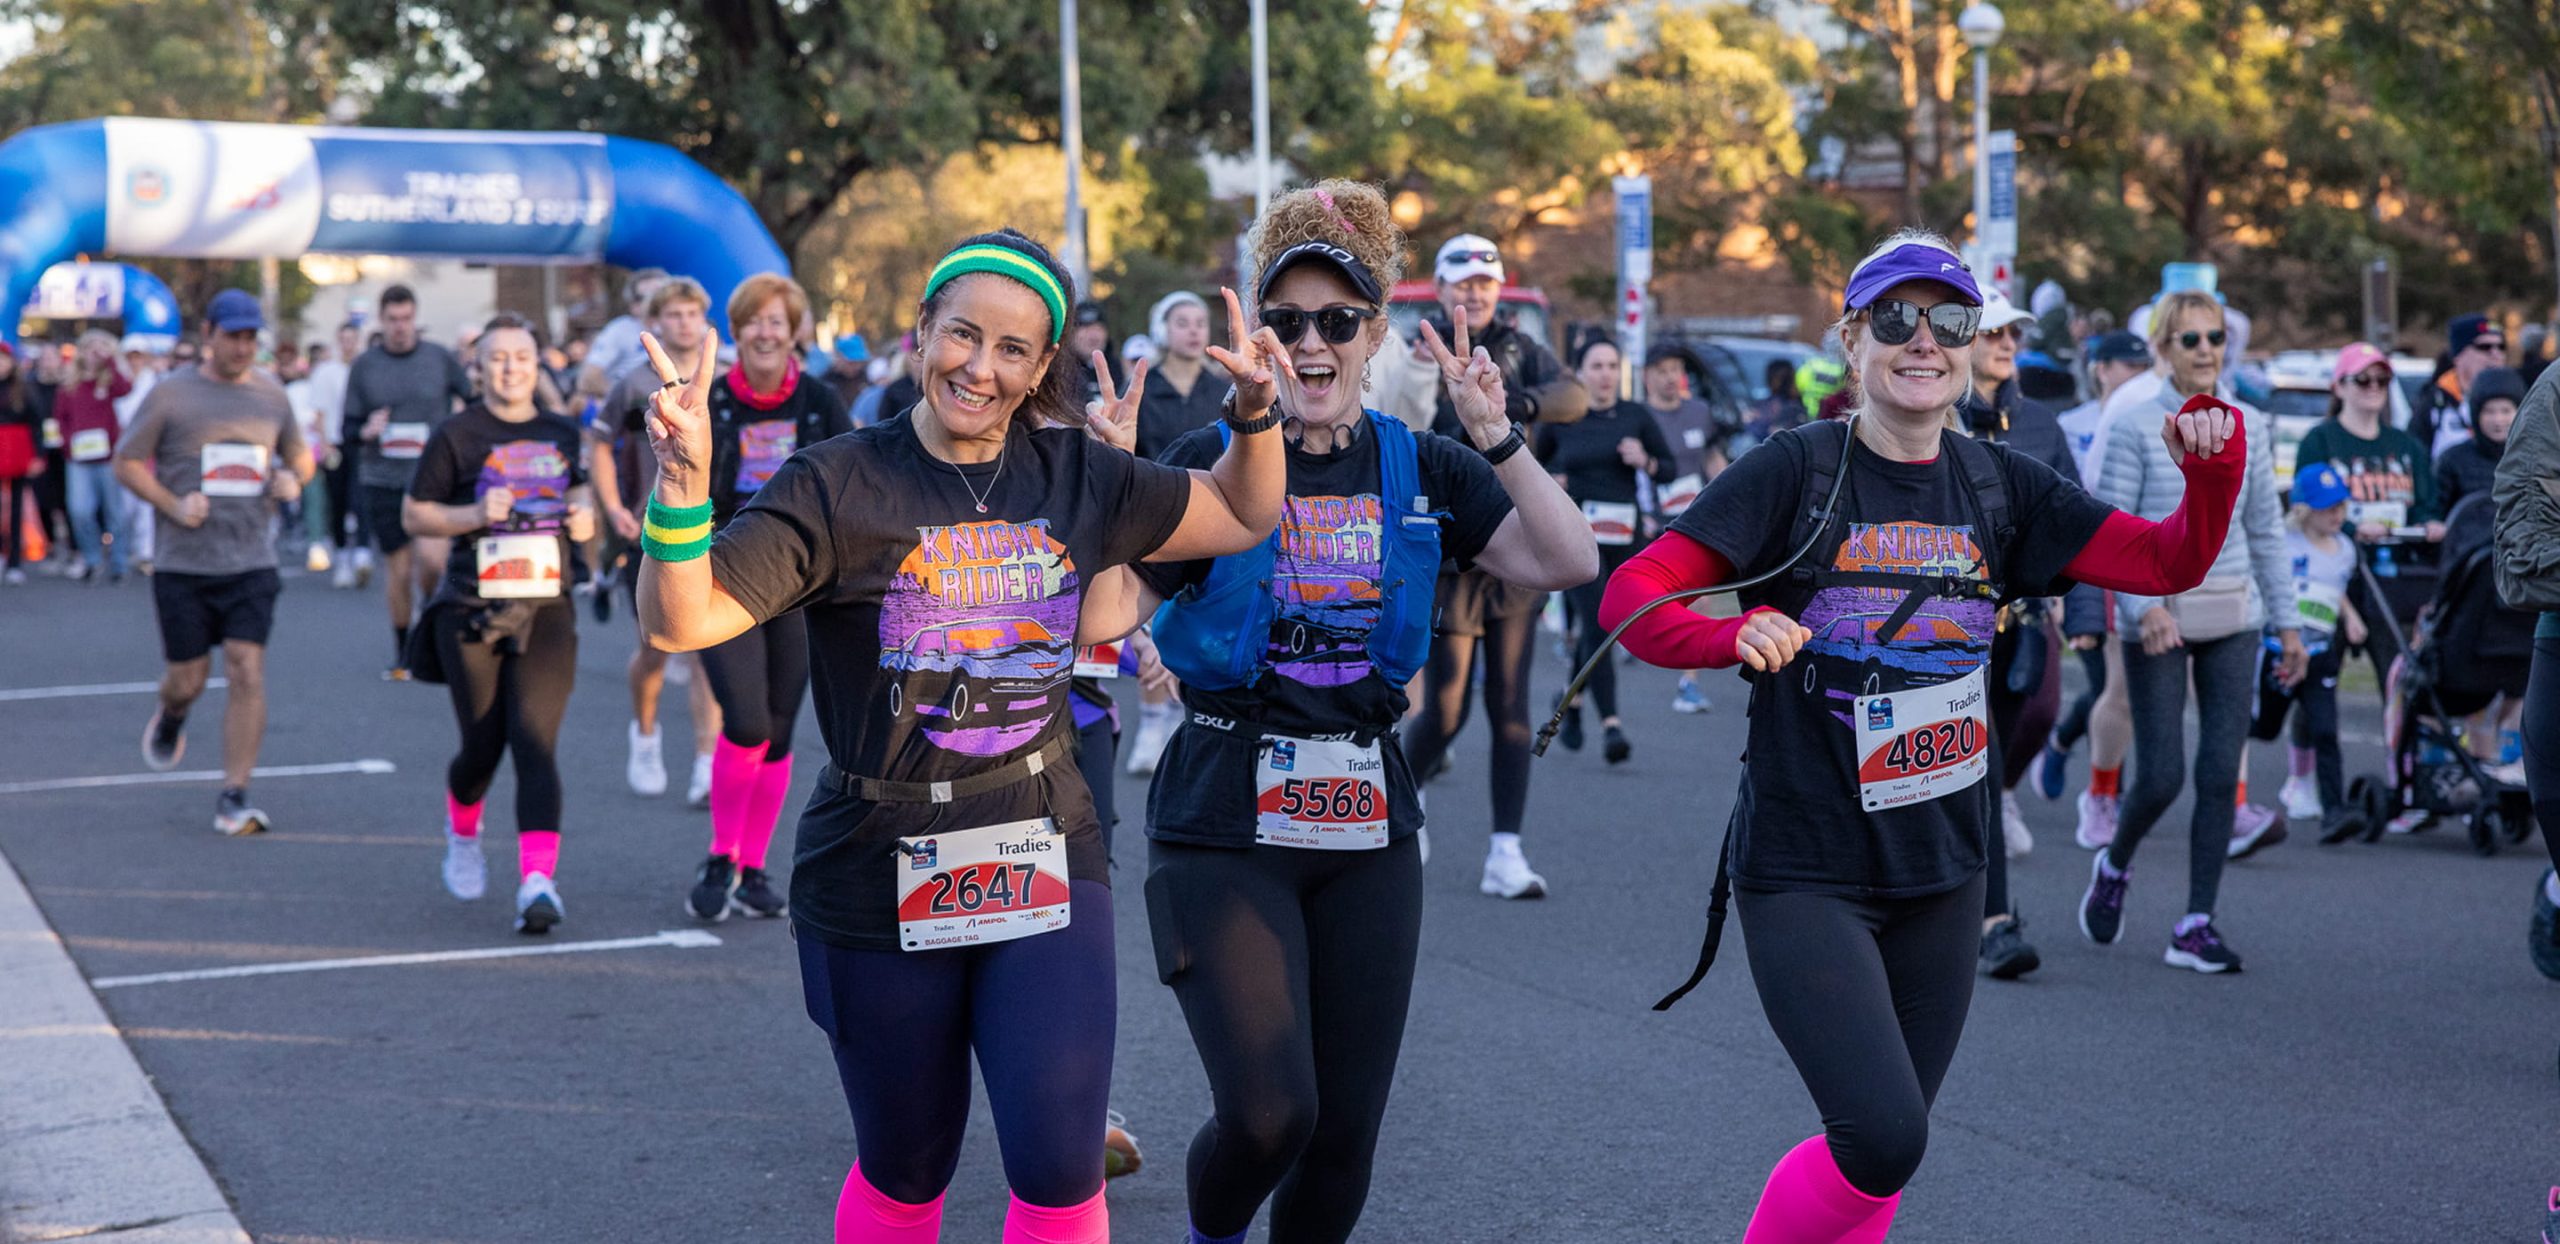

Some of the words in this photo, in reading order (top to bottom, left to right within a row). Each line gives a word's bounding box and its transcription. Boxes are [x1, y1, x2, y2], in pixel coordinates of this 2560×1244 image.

[404, 171, 521, 200] TRADIES
[329, 194, 512, 224] SUTHERLAND
[513, 199, 533, 224] 2
[916, 518, 1052, 567] KNIGHT
[1848, 522, 1975, 564] KNIGHT
[938, 562, 1048, 610] RIDER
[1946, 690, 1981, 713] Tradies
[1193, 712, 1236, 731] 2XU
[1886, 716, 1975, 773] 4820
[1280, 778, 1373, 819] 5568
[1884, 793, 1917, 805] BAGGAGE
[1918, 790, 1931, 798] TAG
[995, 838, 1052, 856] Tradies
[1270, 834, 1304, 844] BAGGAGE
[930, 862, 1037, 914] 2647
[977, 917, 1008, 925] AMPOL
[925, 935, 962, 945] BAGGAGE
[964, 934, 979, 942] TAG
